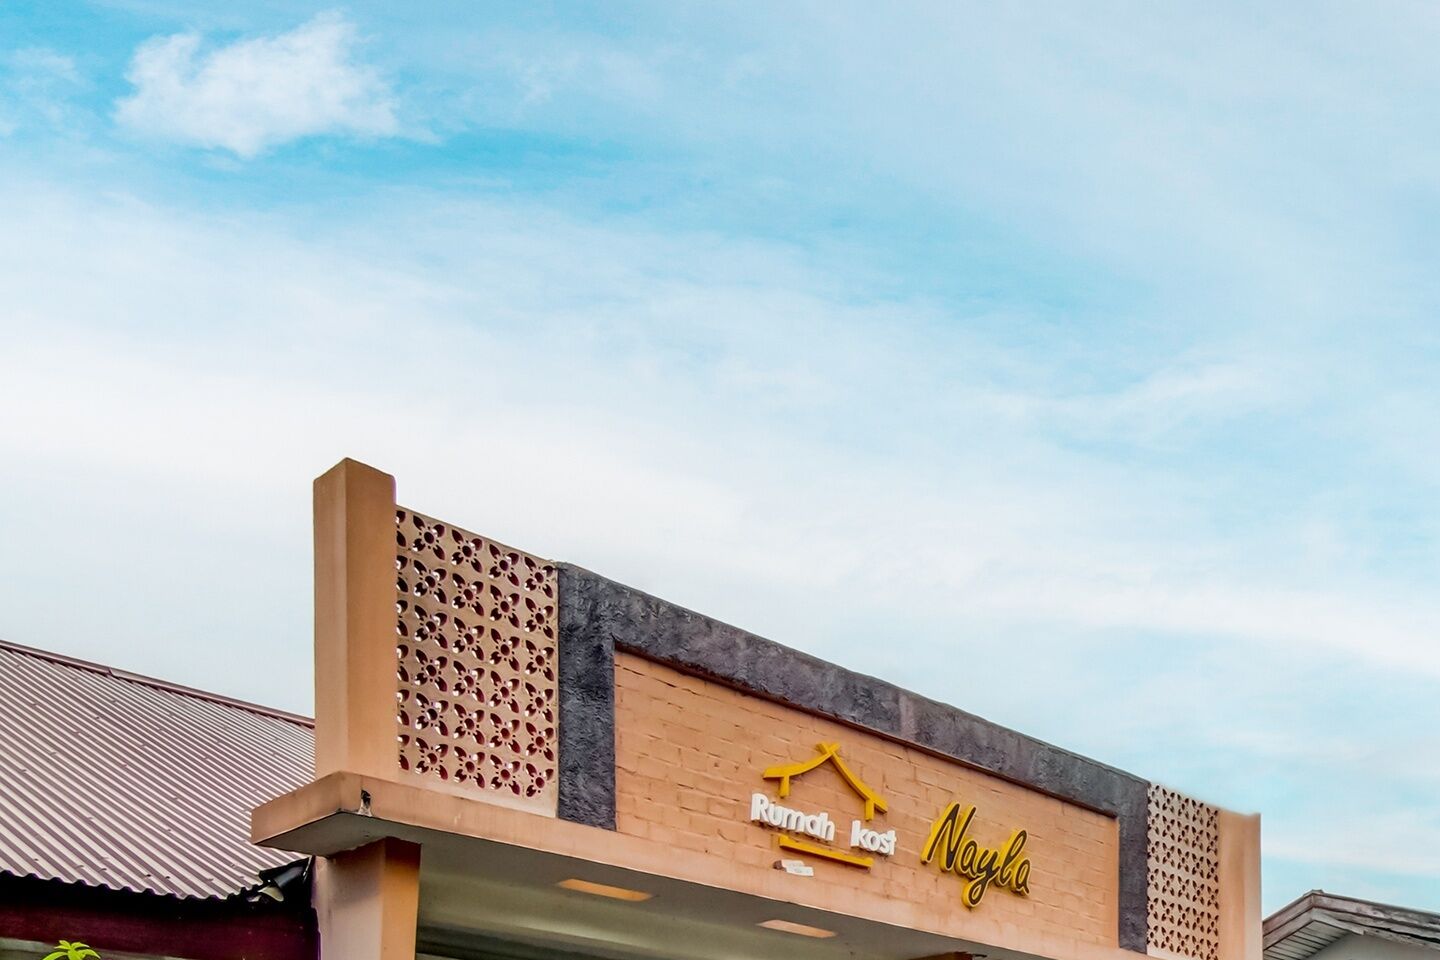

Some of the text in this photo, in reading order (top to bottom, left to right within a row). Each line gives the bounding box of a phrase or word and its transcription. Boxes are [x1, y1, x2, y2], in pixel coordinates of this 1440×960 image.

[750, 793, 1030, 907] Rumah kost Nayla
